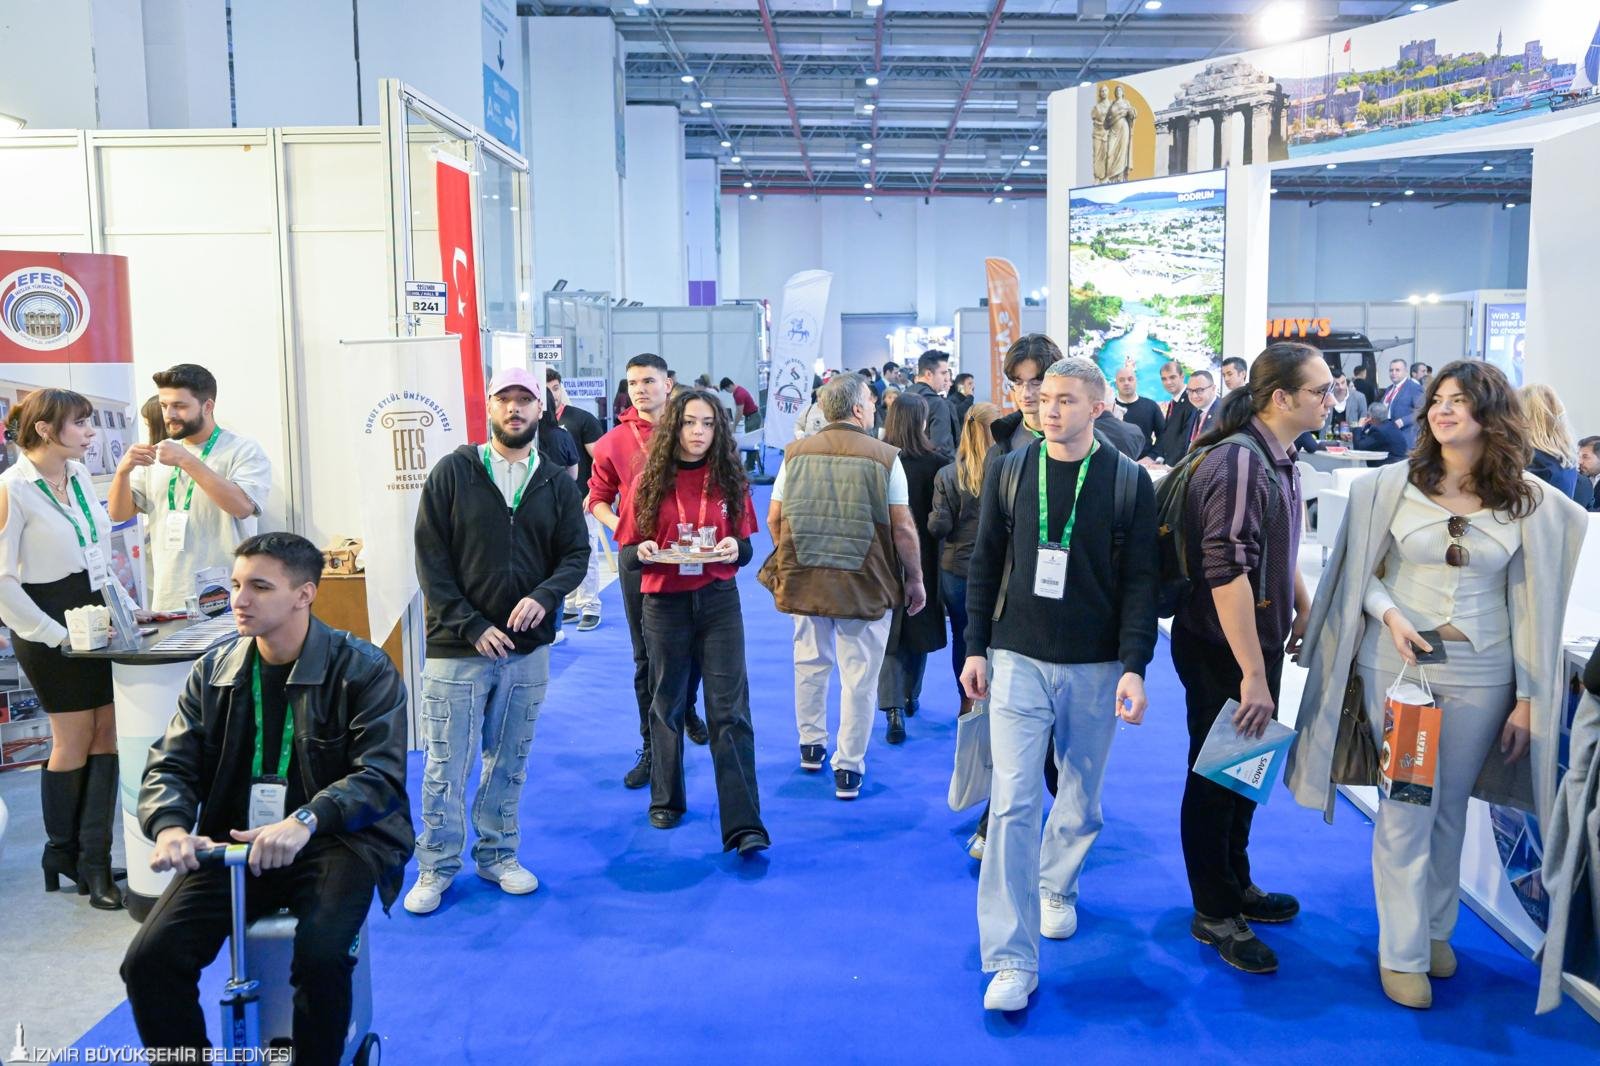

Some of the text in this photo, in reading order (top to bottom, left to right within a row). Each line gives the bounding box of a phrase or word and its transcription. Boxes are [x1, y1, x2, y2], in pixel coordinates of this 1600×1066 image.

[1177, 190, 1215, 202] BODRUM
[17, 272, 64, 287] EFES
[412, 301, 439, 311] B241
[1491, 312, 1509, 320] With
[365, 391, 453, 434] DOKUZ EYLÜL ÜNİVERSİTESİ
[392, 428, 427, 471] EFES
[1252, 756, 1268, 785] SAMOS
